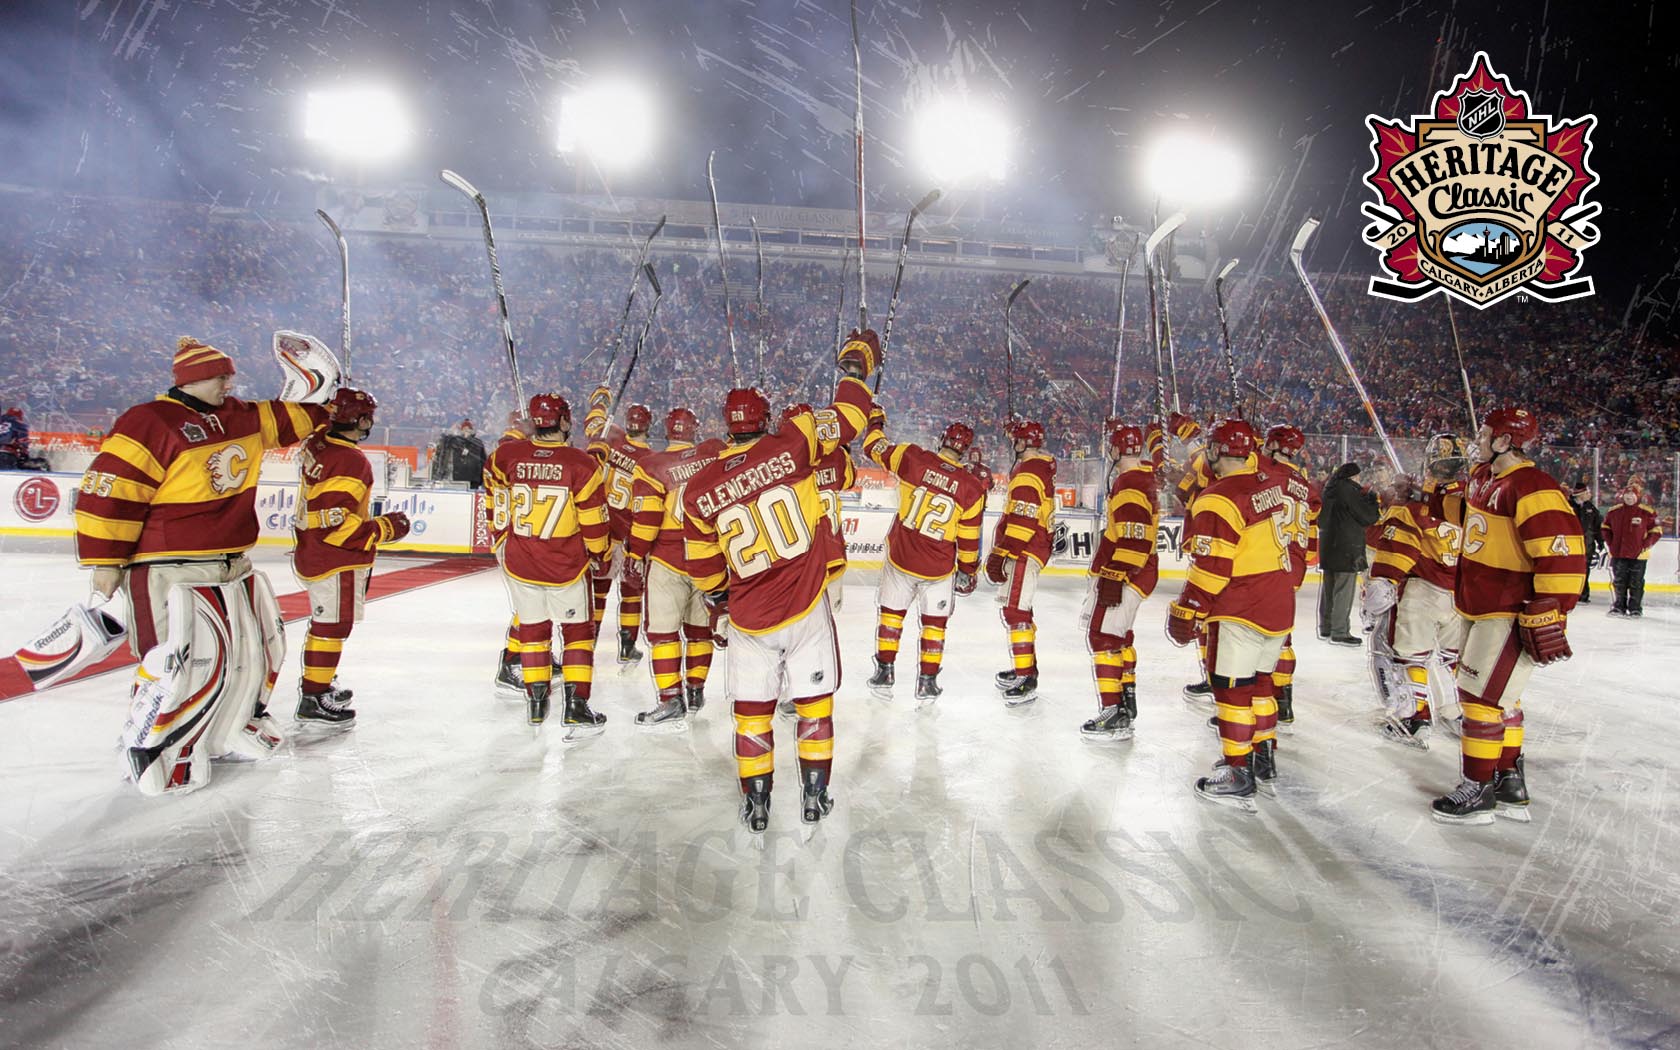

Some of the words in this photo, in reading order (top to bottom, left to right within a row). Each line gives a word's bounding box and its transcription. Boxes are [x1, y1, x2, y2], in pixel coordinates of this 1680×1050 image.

[516, 462, 563, 481] STAIOS
[696, 452, 796, 518] GLENCROSS
[922, 468, 959, 495] IGINLA
[14, 477, 60, 523] LG
[511, 483, 569, 540] 27
[902, 485, 955, 541] 12
[1487, 487, 1500, 511] A
[717, 484, 812, 579] 20
[34, 618, 74, 651] Reebok
